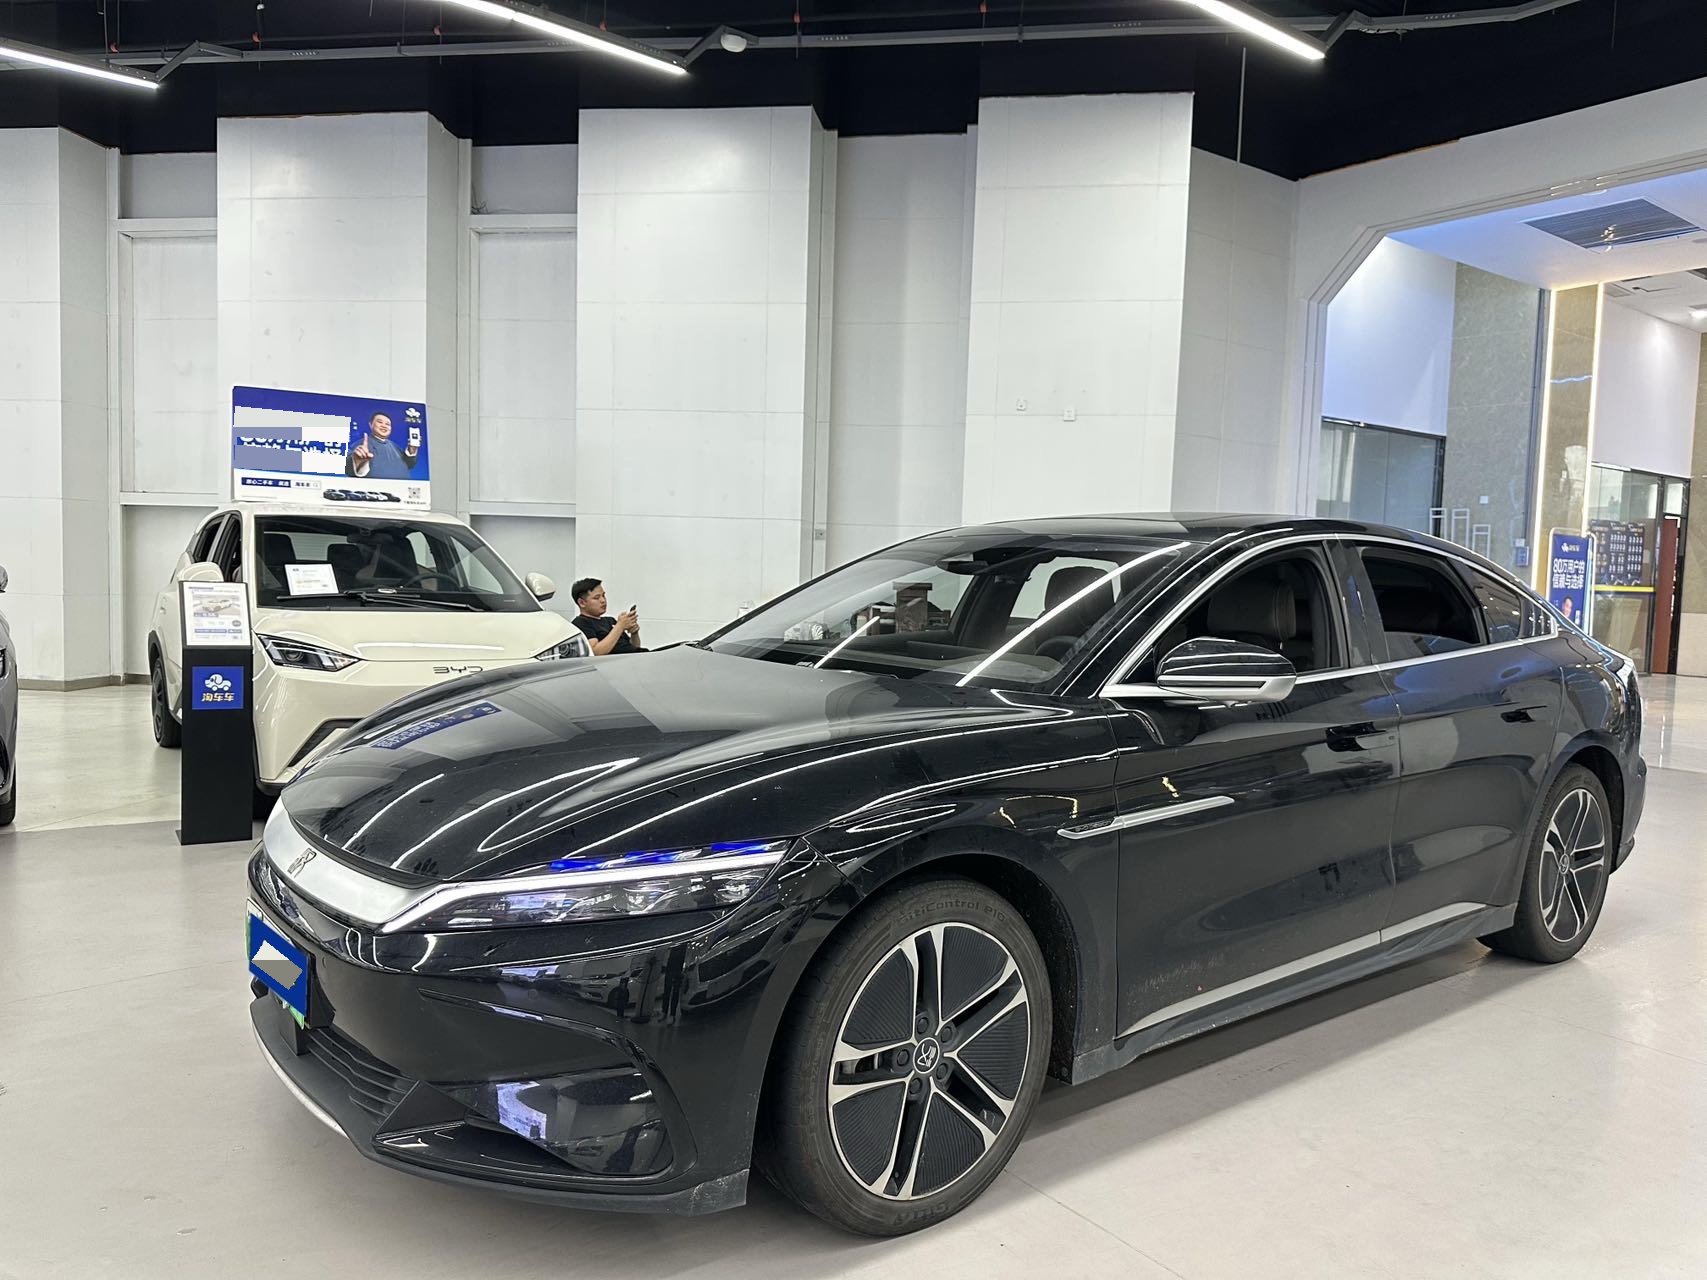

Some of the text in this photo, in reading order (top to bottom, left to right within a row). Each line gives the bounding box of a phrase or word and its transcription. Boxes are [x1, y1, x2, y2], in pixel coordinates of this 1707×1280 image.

[1553, 558, 1585, 574] 80万用户的
[432, 665, 484, 674] BYD
[201, 692, 235, 702] 淘车车
